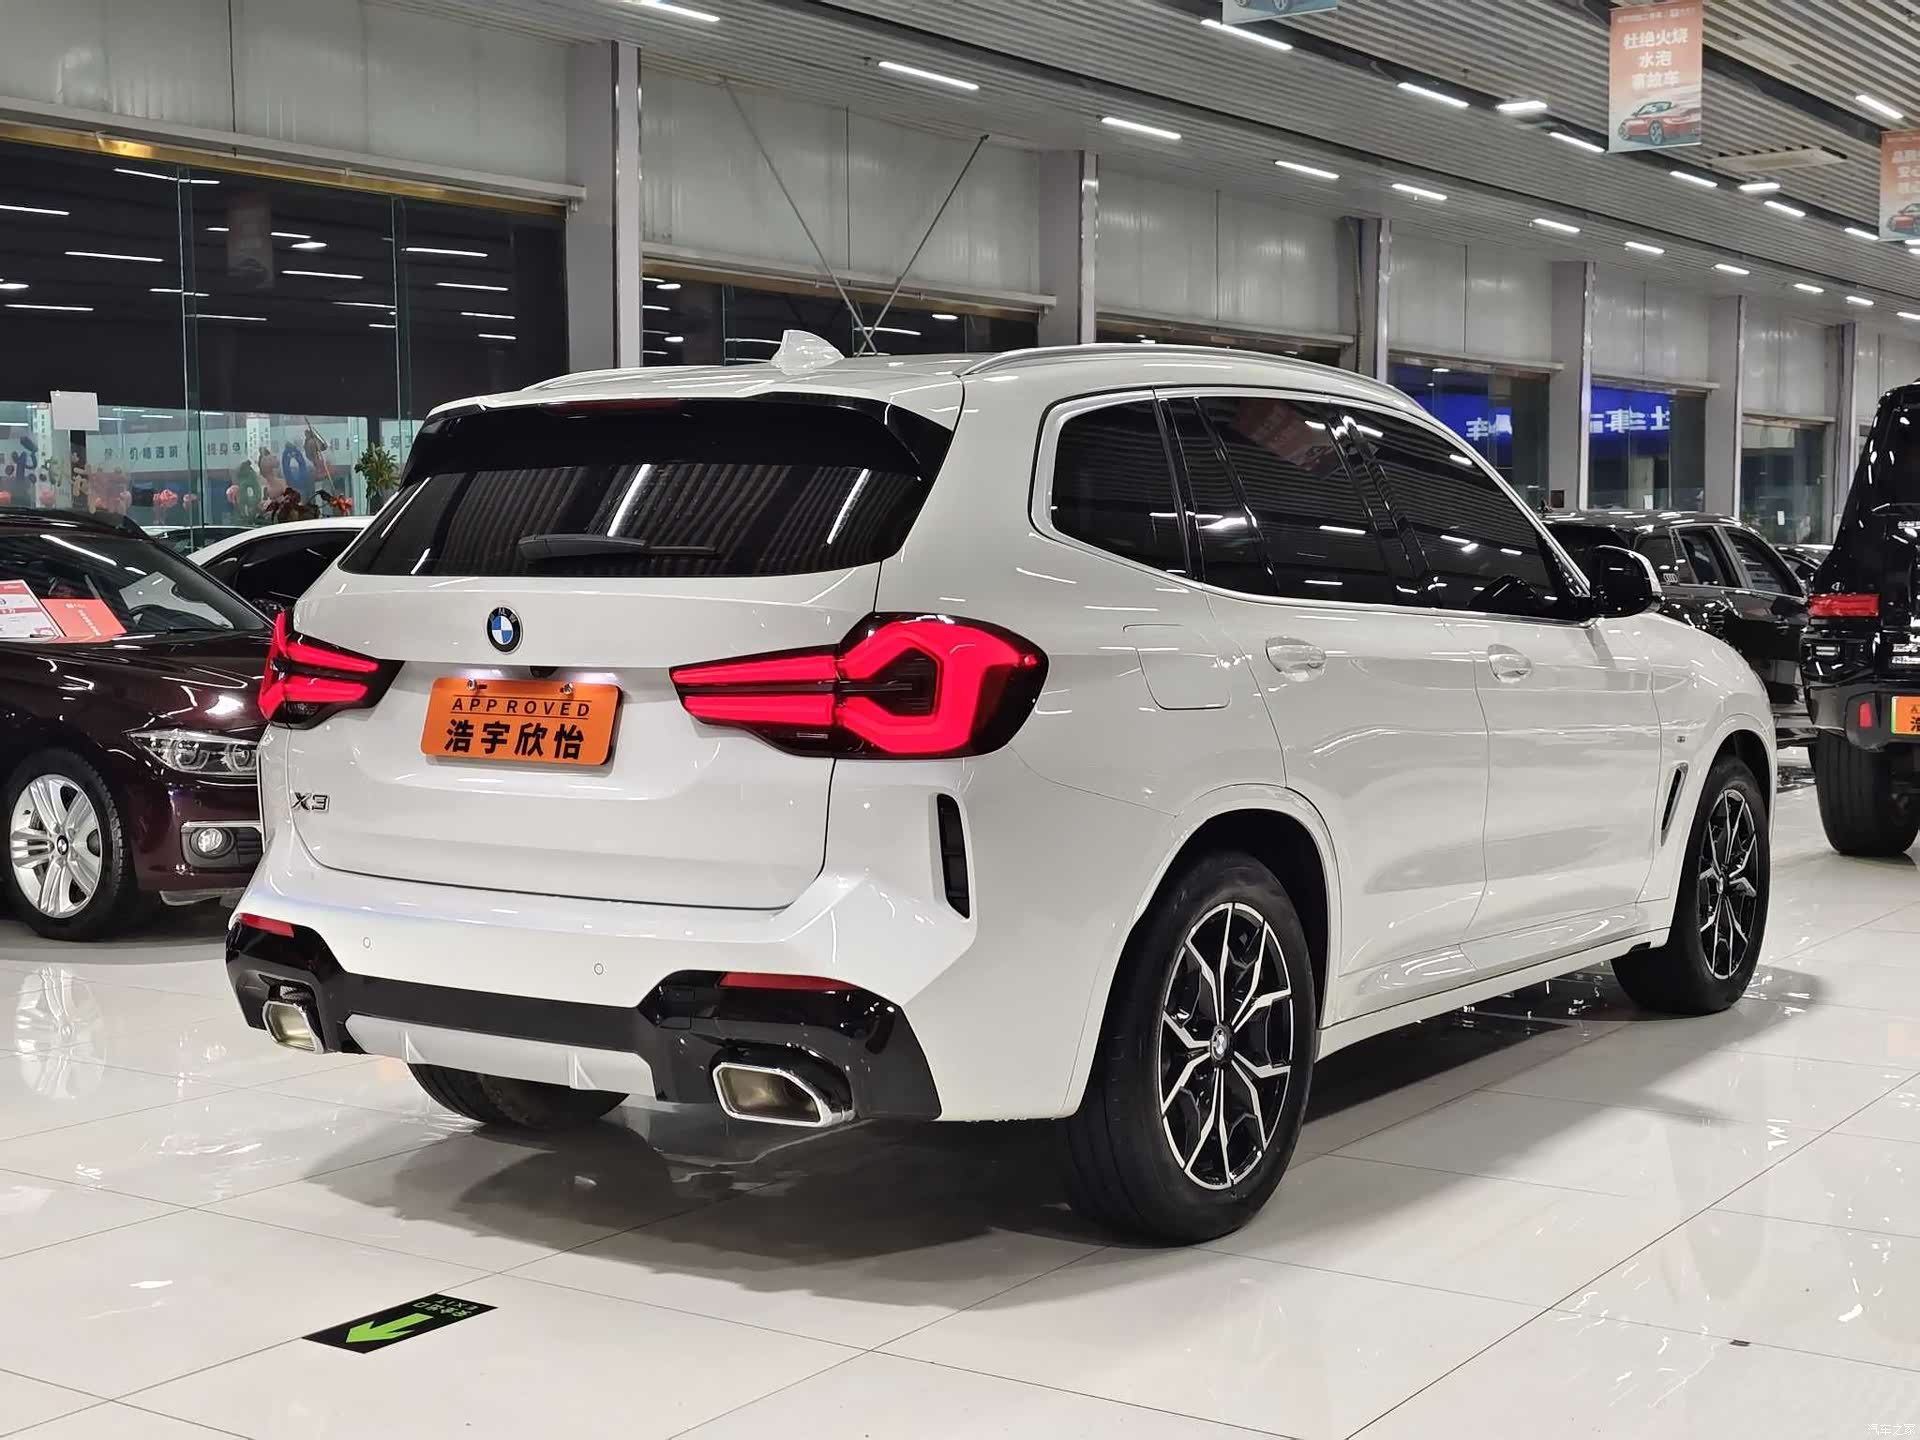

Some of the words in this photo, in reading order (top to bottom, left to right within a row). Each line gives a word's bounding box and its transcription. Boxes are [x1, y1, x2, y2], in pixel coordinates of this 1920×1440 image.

[1623, 27, 1688, 49] 杜绝火烧
[1639, 49, 1672, 69] 水泡
[444, 718, 585, 760] 浩宇欣怡
[291, 792, 330, 812] X3
